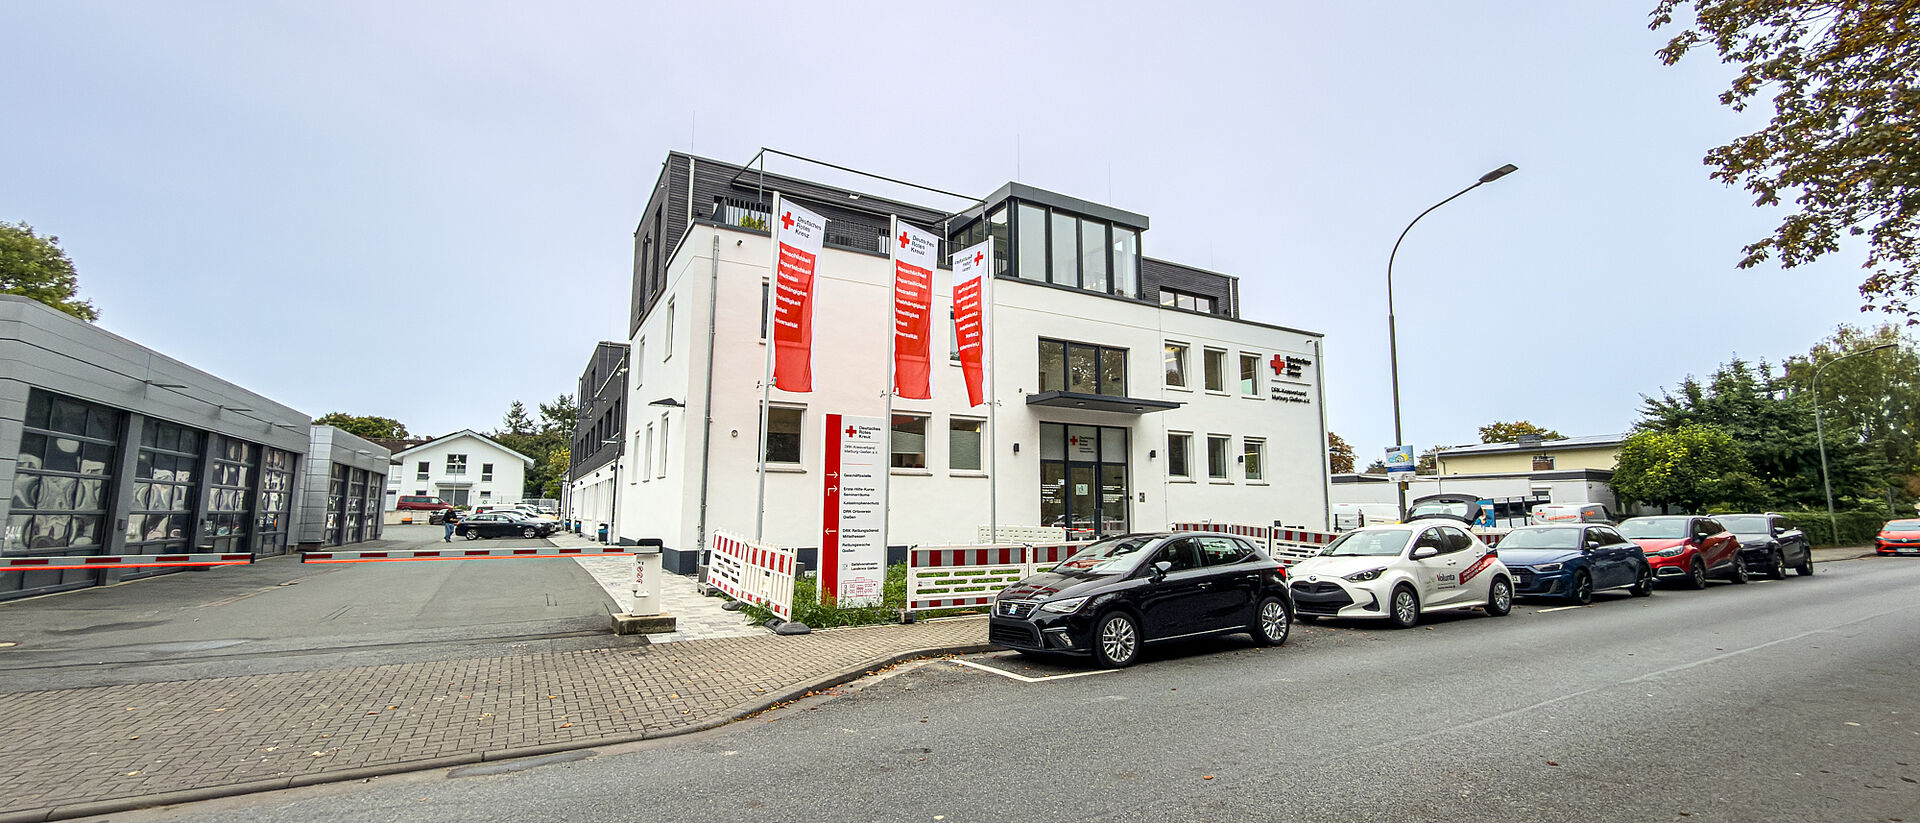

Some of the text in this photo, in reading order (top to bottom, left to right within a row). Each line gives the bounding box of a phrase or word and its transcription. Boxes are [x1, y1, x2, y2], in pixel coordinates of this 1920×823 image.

[797, 222, 810, 232] Rotes
[798, 216, 821, 230] Deutsches
[795, 229, 809, 238] Kreuz
[912, 241, 925, 250] Rotes
[913, 235, 934, 248] Deutsches
[911, 247, 925, 256] Kreuz
